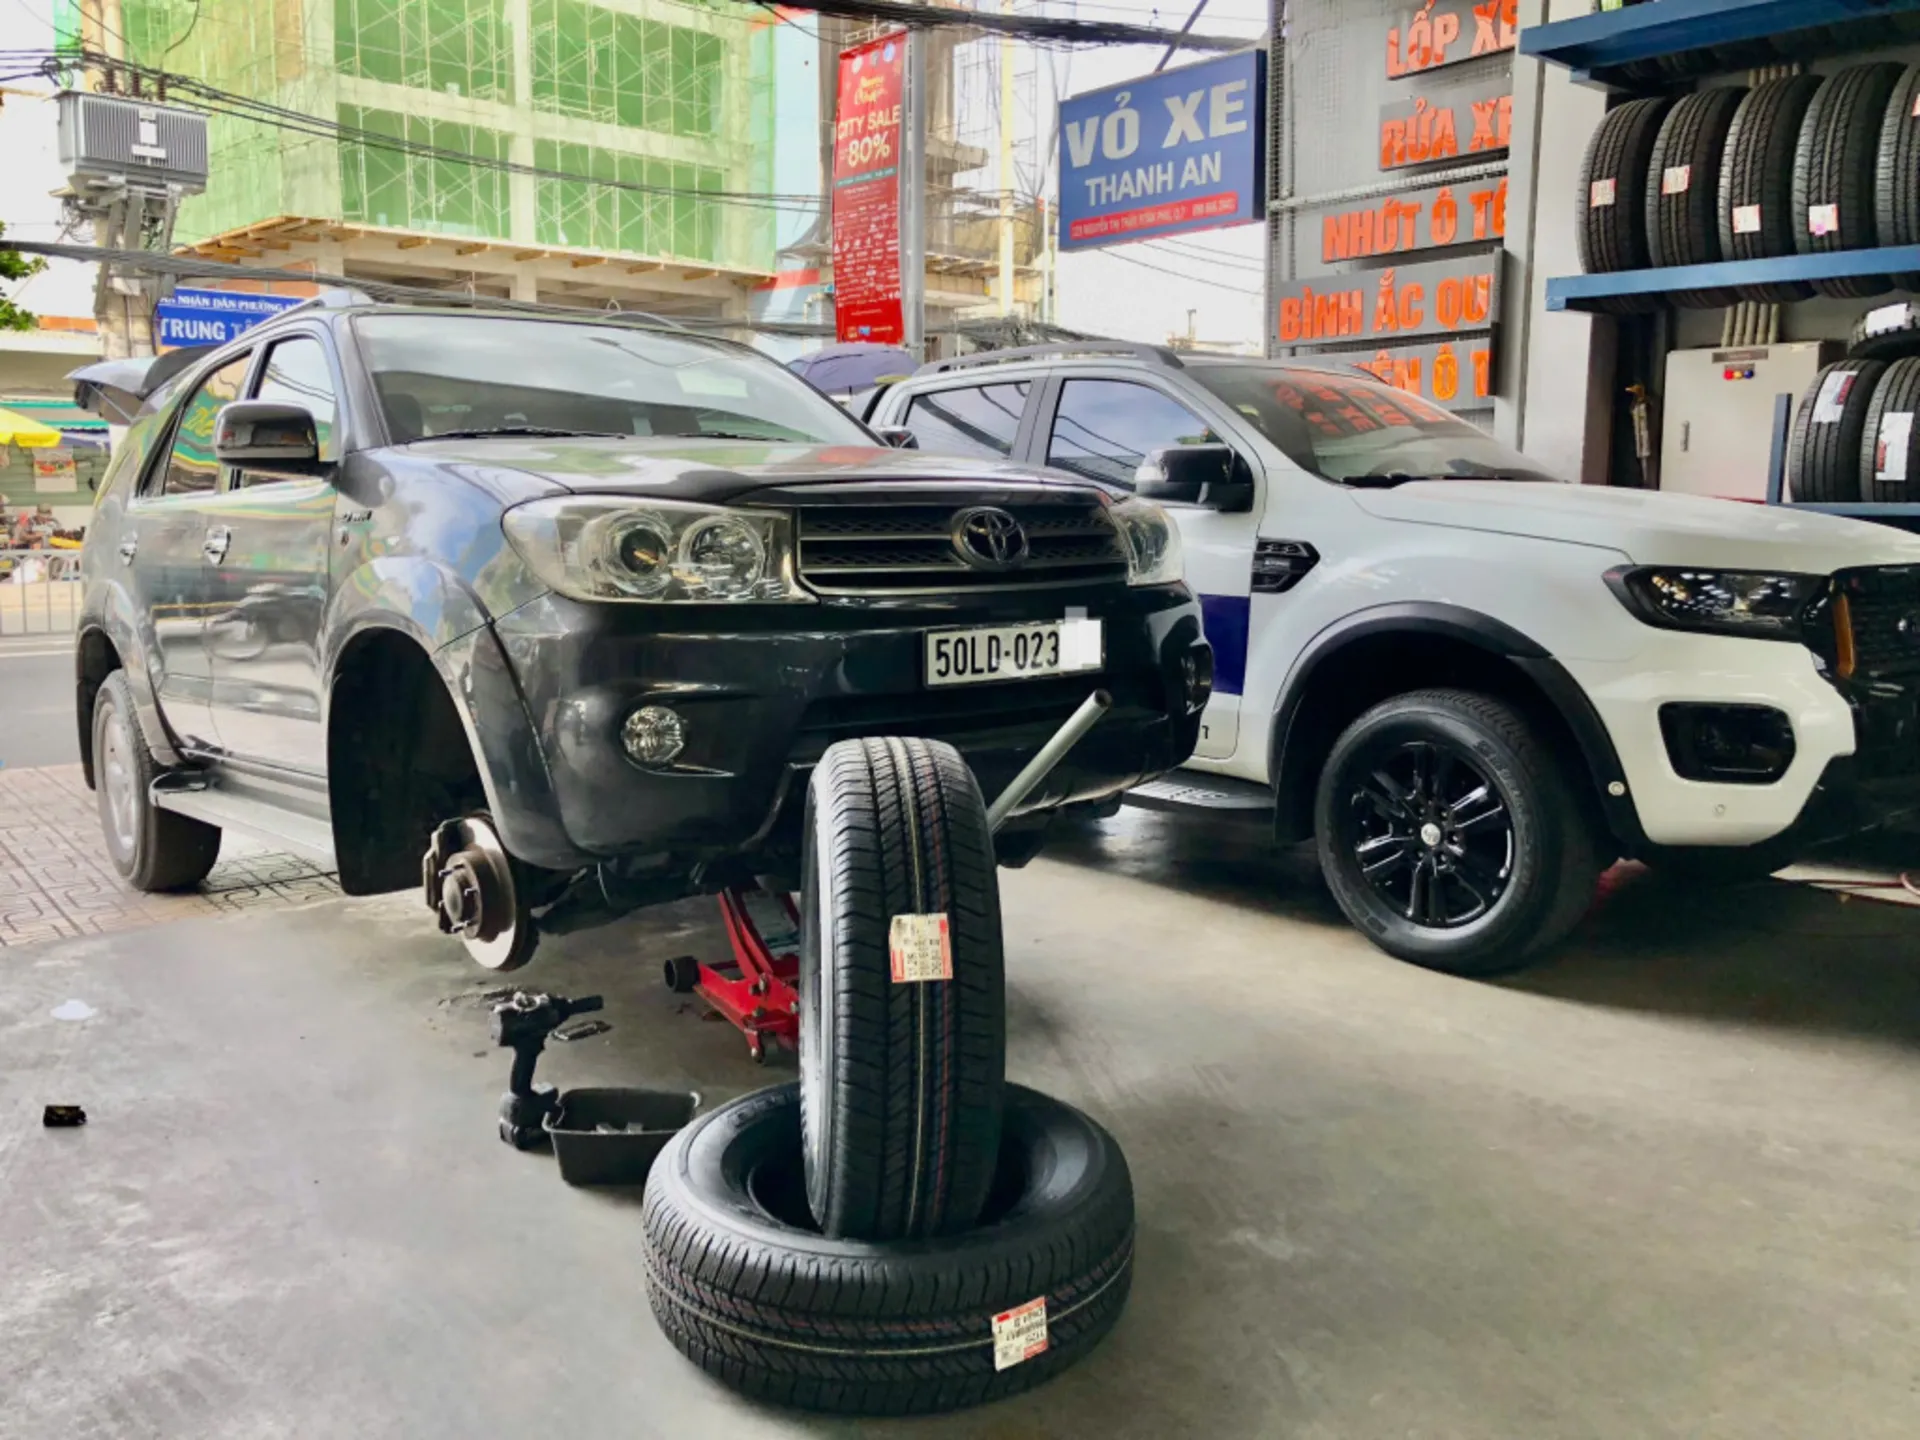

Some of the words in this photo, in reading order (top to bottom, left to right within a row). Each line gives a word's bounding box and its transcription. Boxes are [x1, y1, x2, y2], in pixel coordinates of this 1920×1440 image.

[1386, 0, 1460, 78] LỐP
[1470, 0, 1517, 57] XE
[838, 115, 866, 140] CITY
[867, 104, 901, 131] SALE
[847, 130, 891, 168] 80%
[1064, 91, 1140, 169] VỎ
[1161, 79, 1248, 149] XE
[1381, 97, 1458, 168] RỬA
[1084, 160, 1175, 208] THANH
[1179, 151, 1221, 190] AN
[1323, 197, 1421, 264] NHỚT
[1431, 186, 1458, 245] Ô
[160, 317, 226, 341] TRUNG
[1279, 286, 1363, 342] BÌNH
[1372, 267, 1425, 334] ẮC
[1435, 273, 1495, 331] QU
[1432, 342, 1459, 401] Ô
[1470, 350, 1490, 398] T
[935, 630, 1060, 678] 50LD-023
